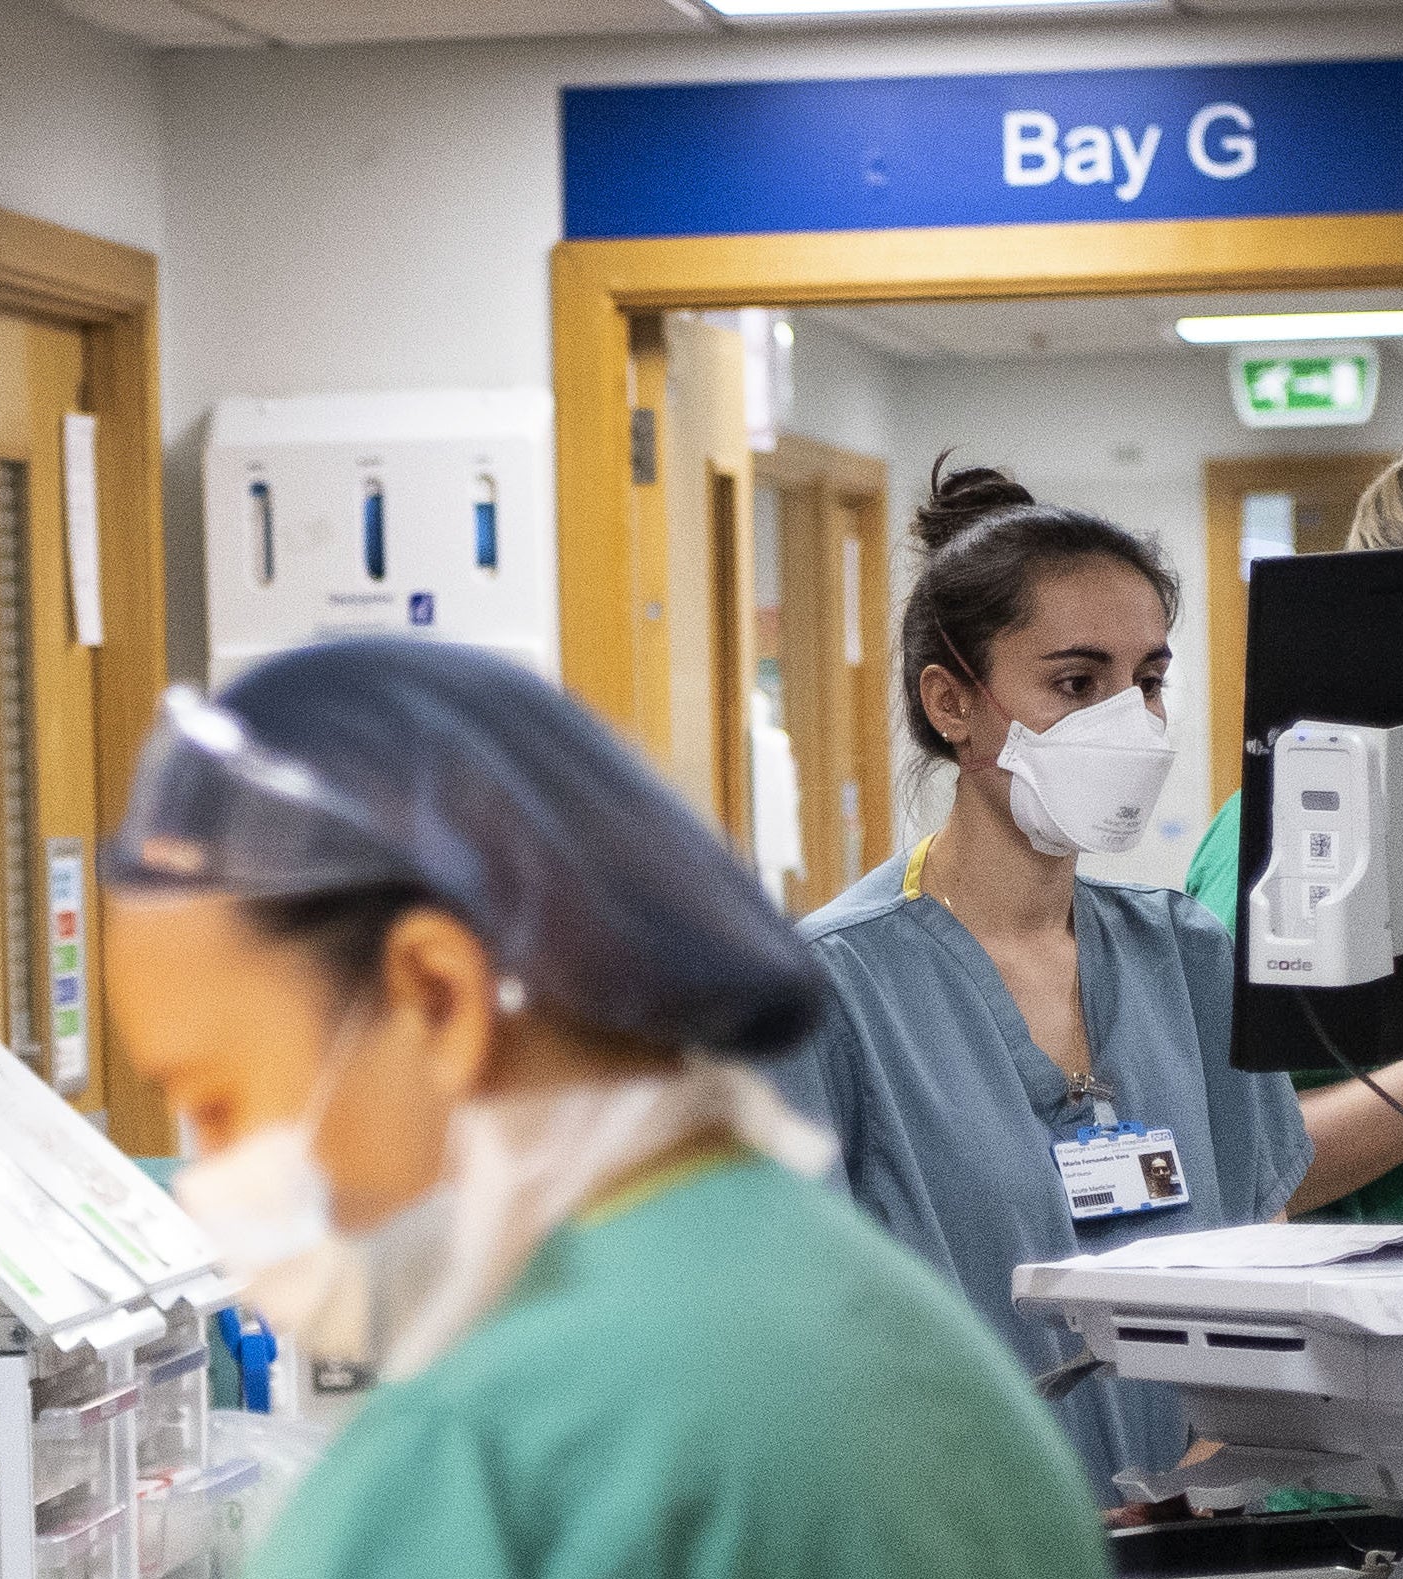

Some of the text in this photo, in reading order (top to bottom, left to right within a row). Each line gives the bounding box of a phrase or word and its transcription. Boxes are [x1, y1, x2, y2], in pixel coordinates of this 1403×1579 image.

[1002, 102, 1257, 201] Bay G
[1266, 958, 1314, 972] code
